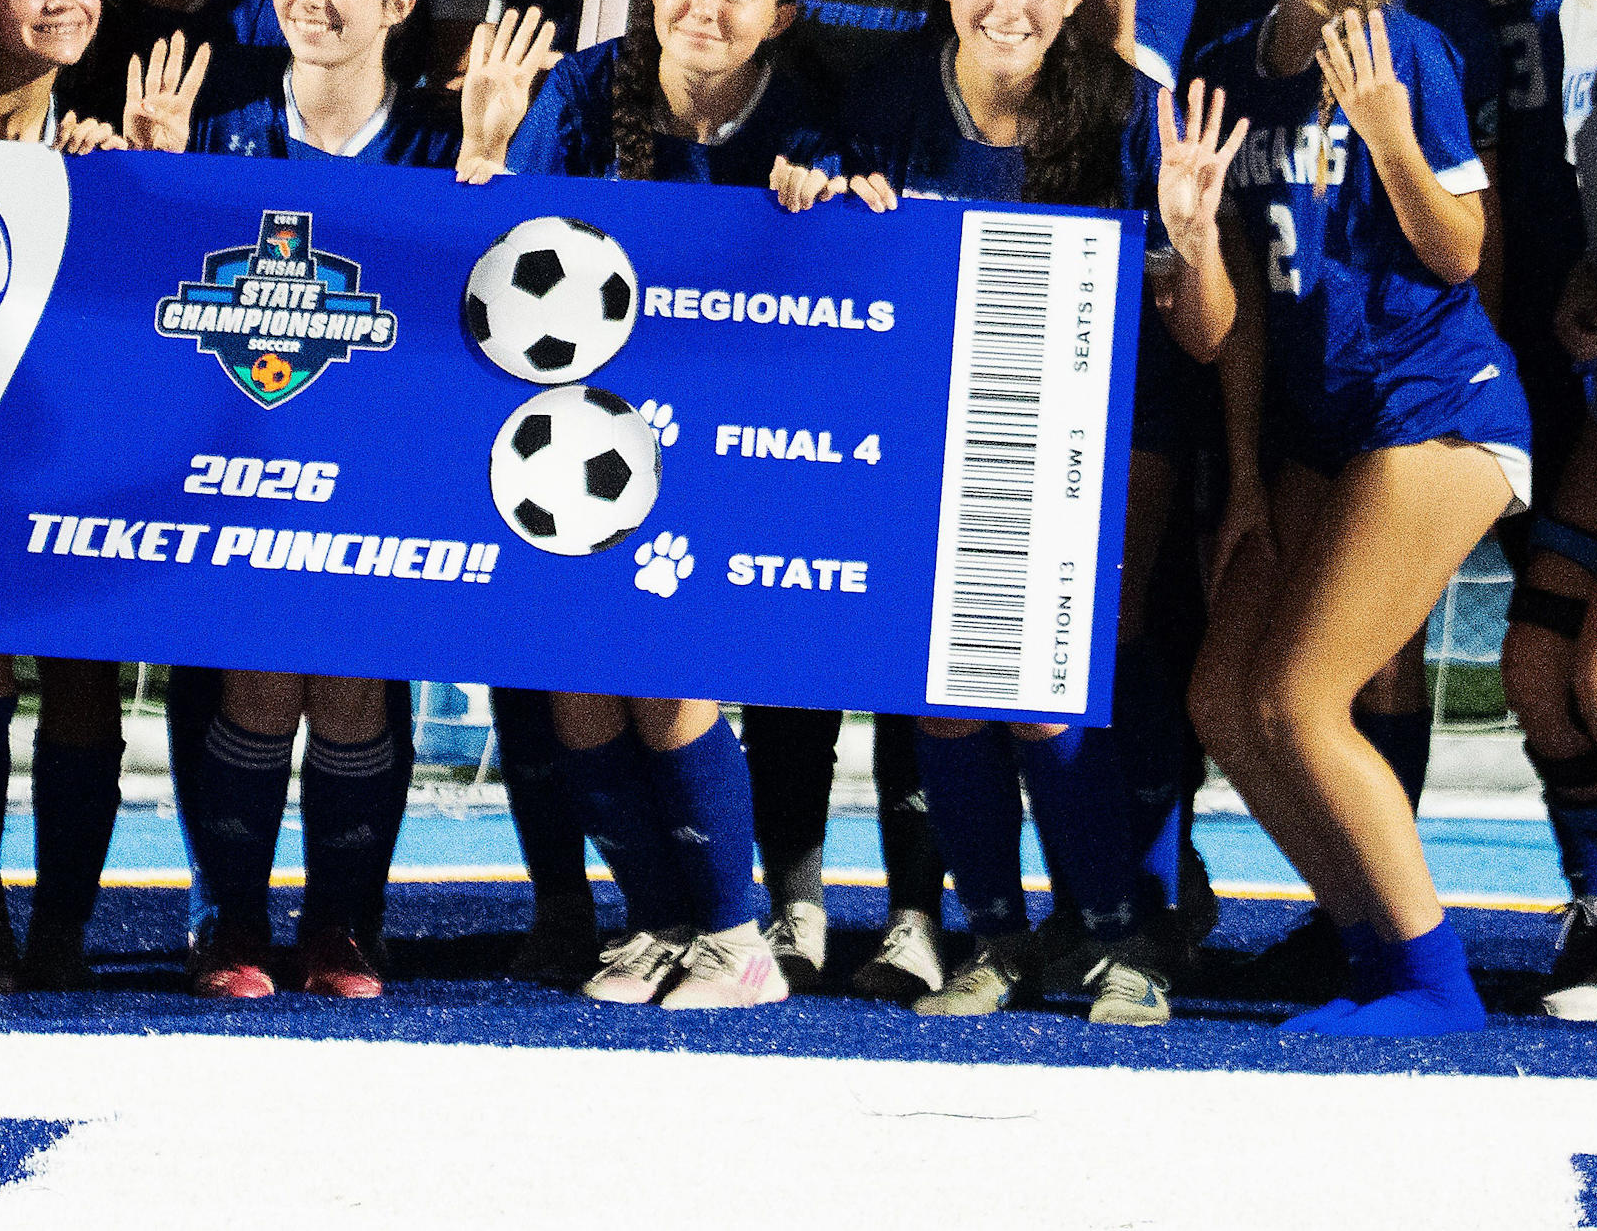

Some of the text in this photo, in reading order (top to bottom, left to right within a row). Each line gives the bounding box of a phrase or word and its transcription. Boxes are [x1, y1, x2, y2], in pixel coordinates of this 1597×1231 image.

[255, 259, 307, 277] FHSAA
[1083, 237, 1098, 259] 11
[1265, 200, 1303, 297] 2
[240, 280, 321, 310] STATE
[1079, 282, 1095, 293] 8
[162, 302, 392, 344] CHAMPIONSHIPS
[643, 286, 896, 332] REGIONALS
[248, 338, 301, 353] SOCCER
[1073, 301, 1093, 373] SEATS
[715, 424, 881, 465] FINAL 4
[1066, 429, 1085, 499] ROW 3
[183, 454, 340, 503] 2026
[27, 512, 500, 584] TICKET PUNCHED!!
[726, 553, 869, 594] STATE
[1051, 561, 1075, 695] SECTION 13
